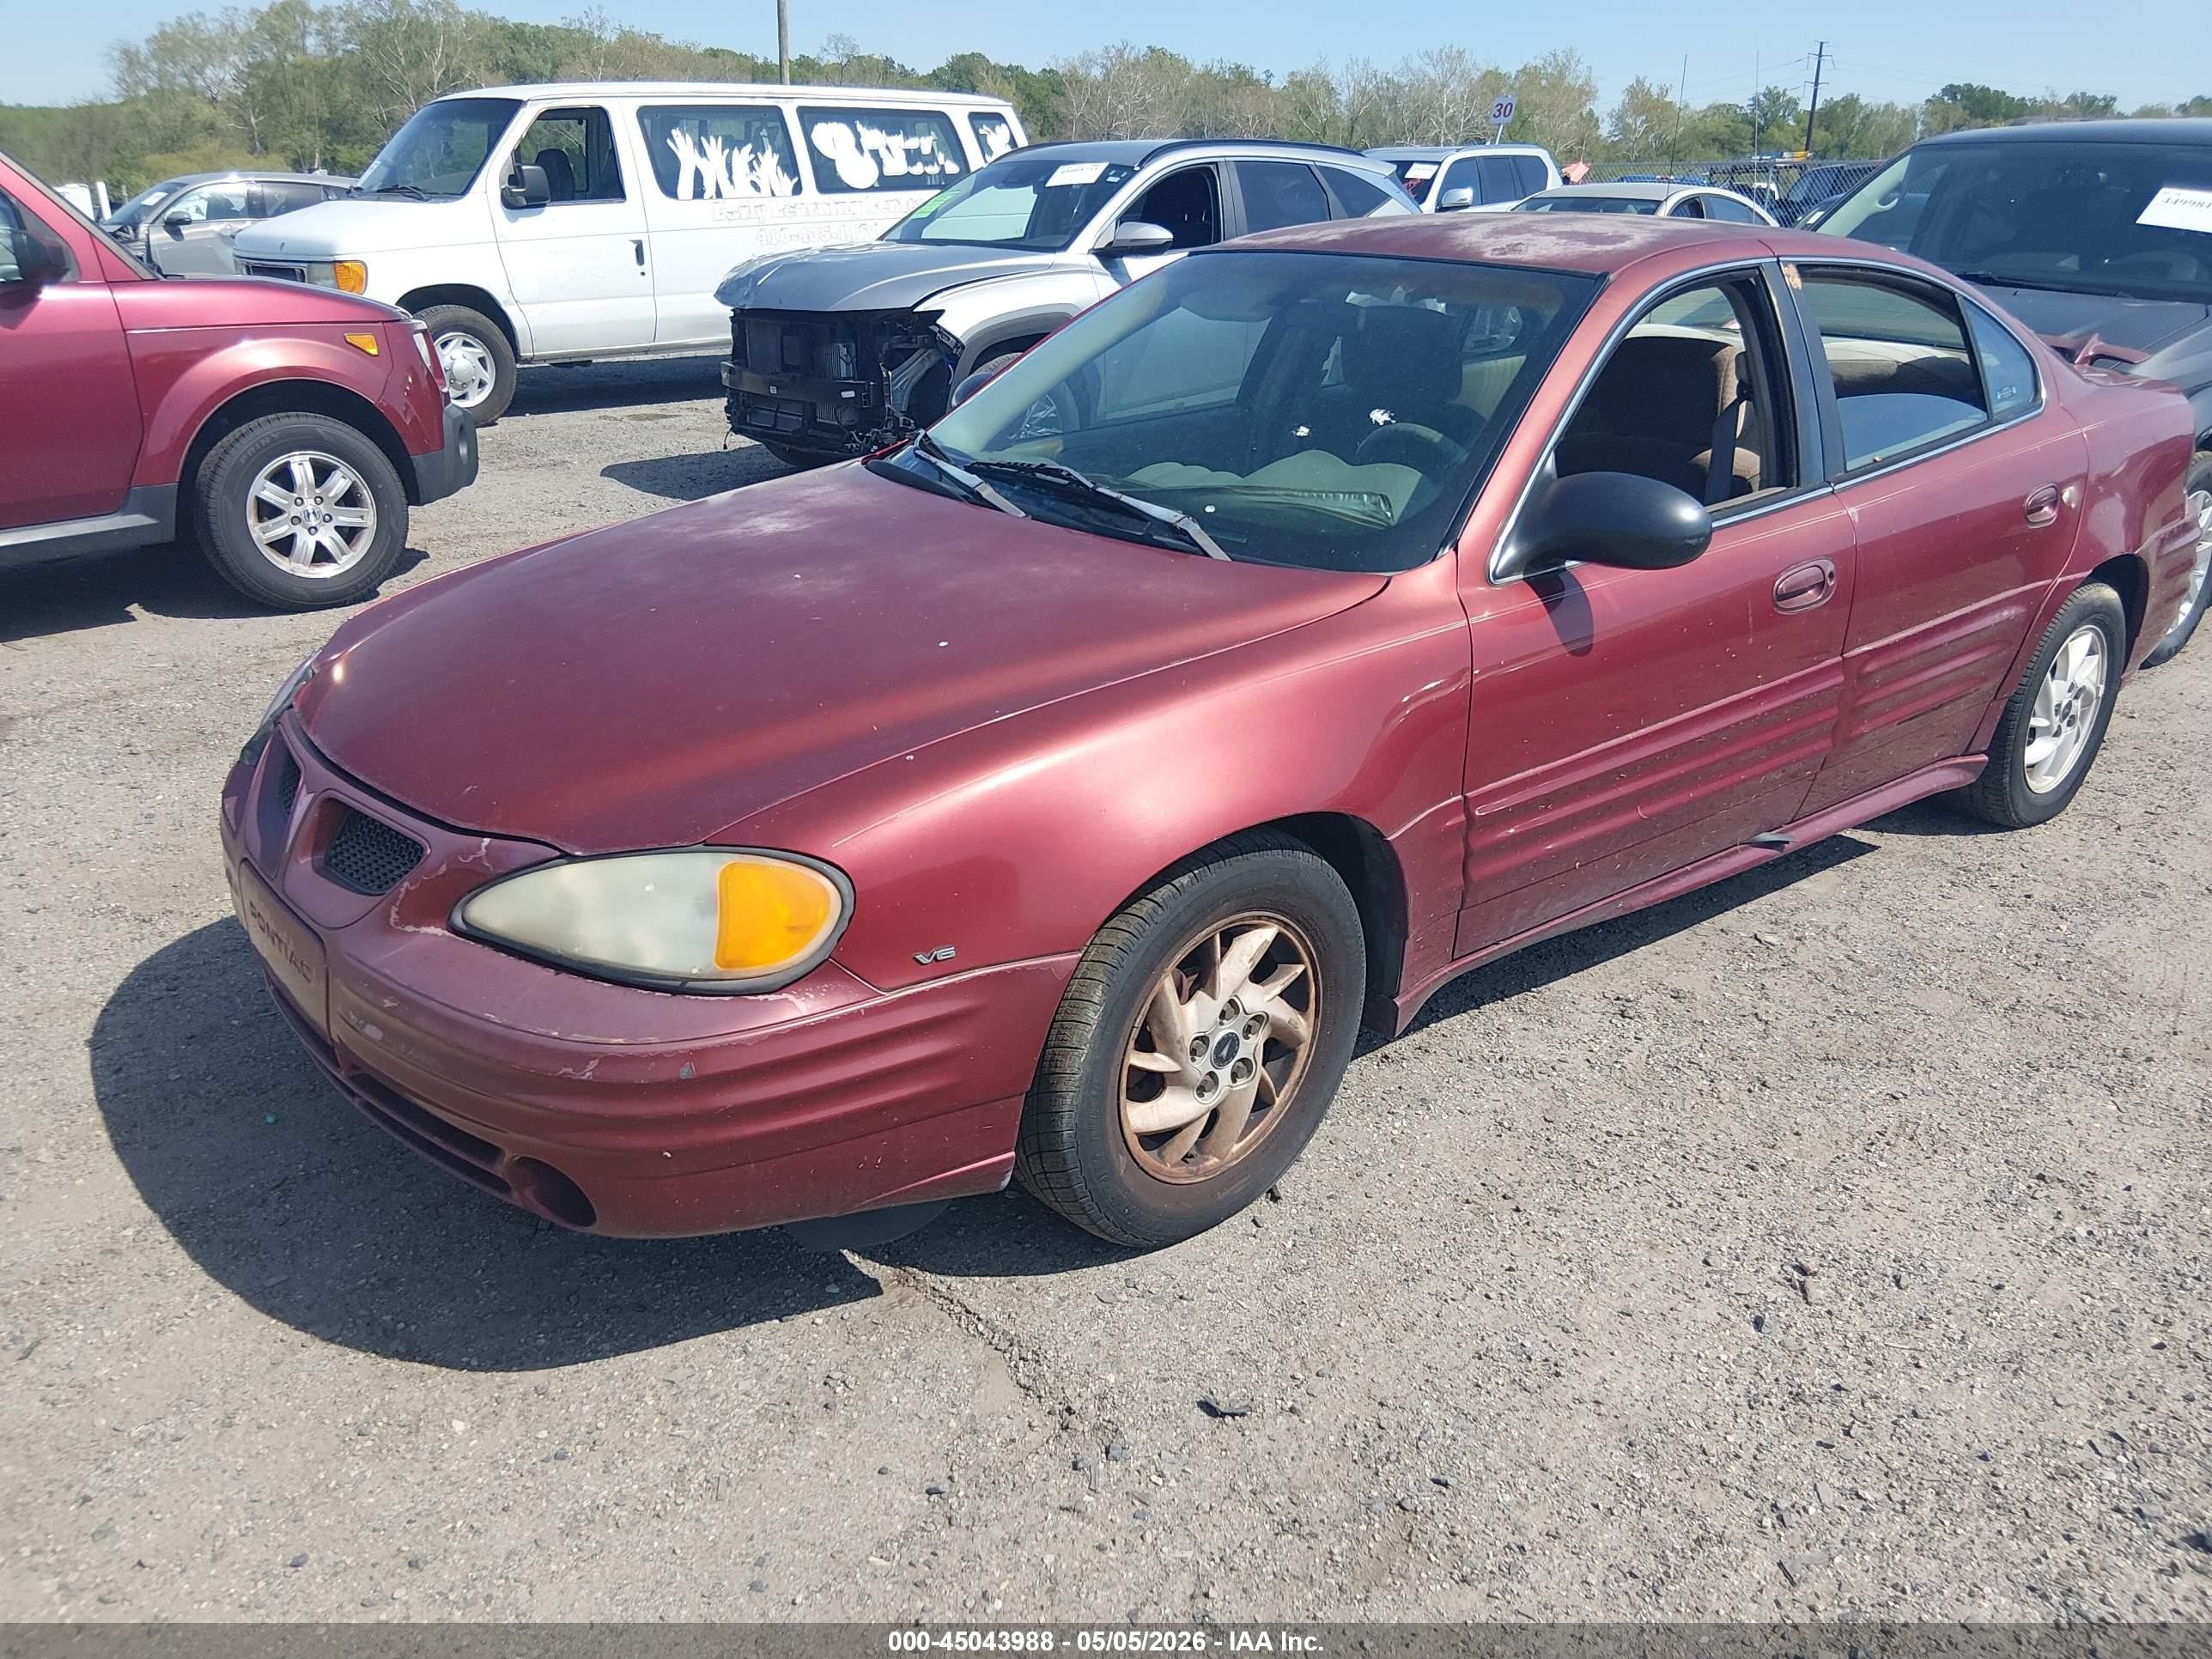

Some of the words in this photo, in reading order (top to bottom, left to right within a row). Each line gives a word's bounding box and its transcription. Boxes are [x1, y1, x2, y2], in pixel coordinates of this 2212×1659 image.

[1492, 102, 1514, 118] 30
[769, 197, 862, 218] Learning
[249, 899, 313, 984] PONTIAC
[913, 945, 957, 965] V6
